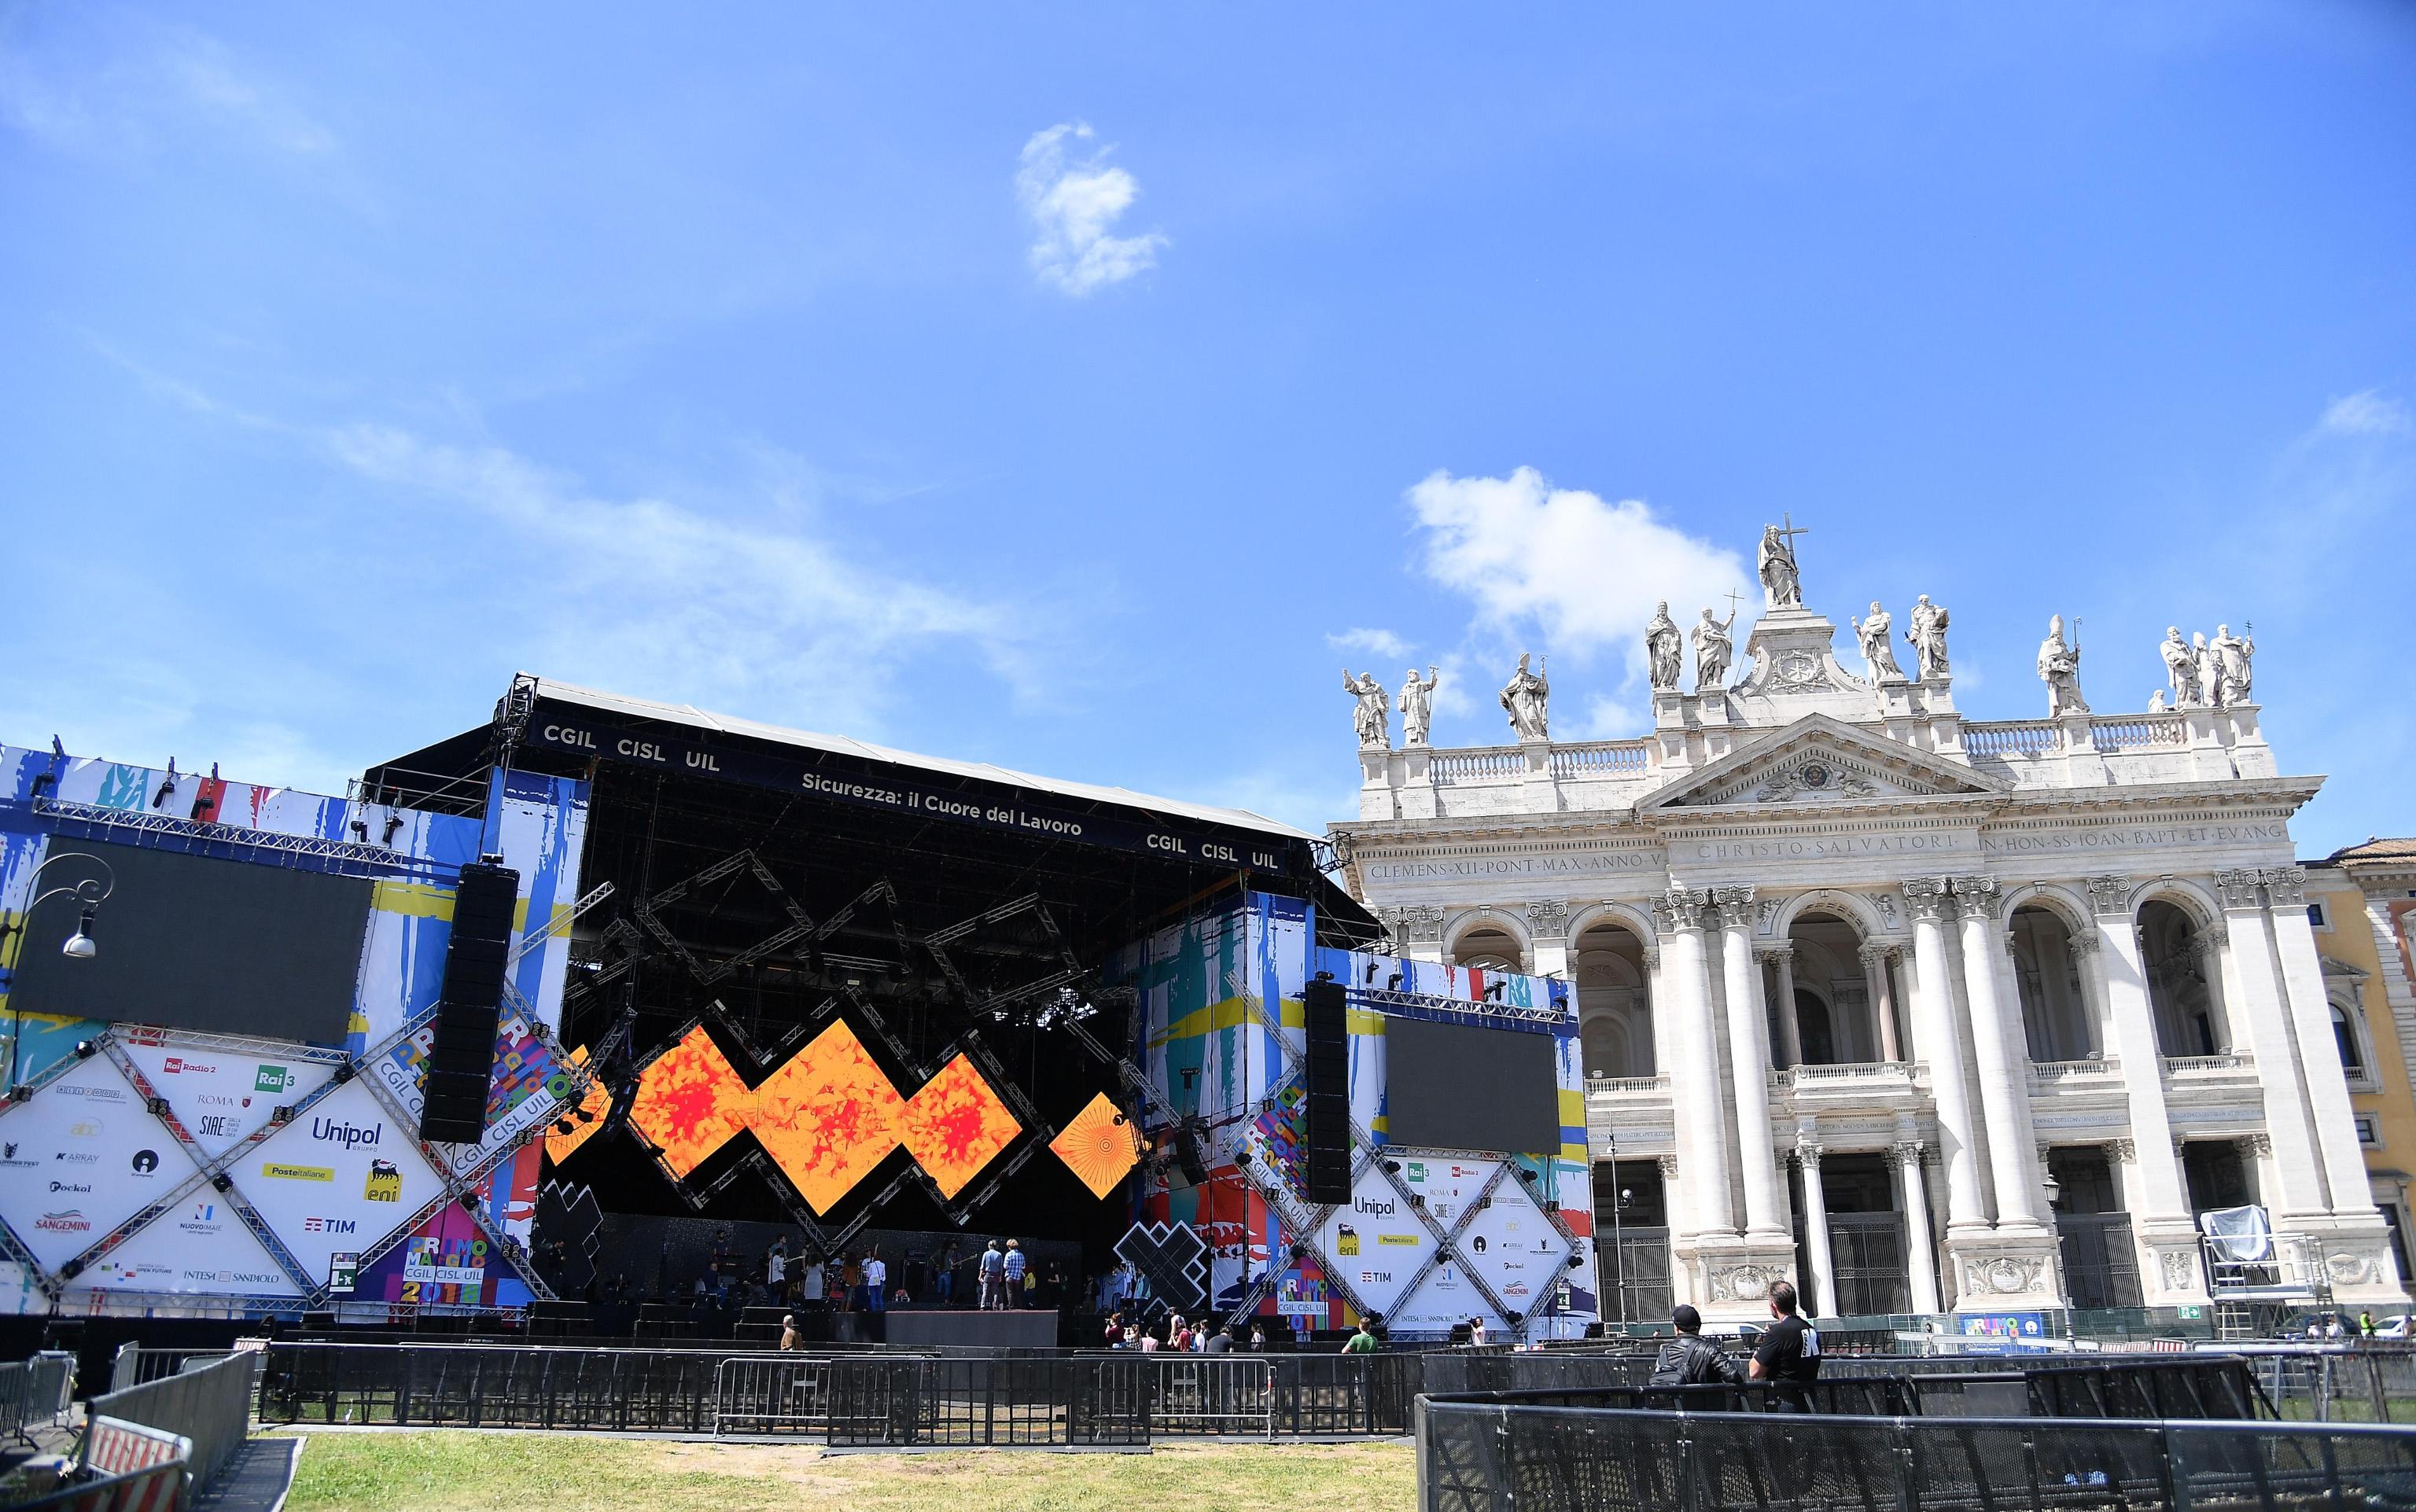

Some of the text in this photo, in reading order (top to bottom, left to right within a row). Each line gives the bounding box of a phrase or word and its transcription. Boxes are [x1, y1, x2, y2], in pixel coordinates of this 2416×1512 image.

[544, 725, 720, 772] CGIL CISL UIL
[802, 773, 1082, 836] Sicurezza: il Cuore del Lavoro
[1979, 825, 2281, 852] IN HON SS IOAN BAPT ET EVANG
[1147, 833, 1278, 869] CGIL CISL UIL
[1697, 835, 1954, 859] CHRISTO SALVATORI
[1371, 863, 1447, 878] CLEMENS
[1455, 862, 1477, 874] XII
[1486, 859, 1534, 874] PONT
[1543, 857, 1582, 871] MAX
[1590, 855, 1642, 869] ANNO
[182, 1064, 208, 1072] Radio
[258, 1072, 295, 1086] Rai 3
[381, 1062, 425, 1120] CGIL CI
[197, 1094, 234, 1106] ROMA
[200, 1116, 226, 1136] SIAE
[313, 1117, 381, 1150] Unipol
[455, 1093, 552, 1171] CGIL CISL UIL
[68, 1153, 100, 1163] ARRAY
[272, 1167, 326, 1179] Posteitaliane
[1409, 1168, 1423, 1177] Rai
[368, 1186, 398, 1202] eni
[1354, 1196, 1395, 1220] Unipol
[1434, 1204, 1448, 1218] SIAE
[35, 1220, 90, 1231] SANGEMINI
[326, 1219, 355, 1234] TIM
[408, 1236, 488, 1256] PRIMO
[1339, 1243, 1357, 1256] eni
[184, 1271, 279, 1283] INTESA SANPAOLO
[405, 1268, 481, 1280] CGIL CISL UIL
[1373, 1272, 1391, 1282] TIM
[401, 1282, 481, 1303] 2018
